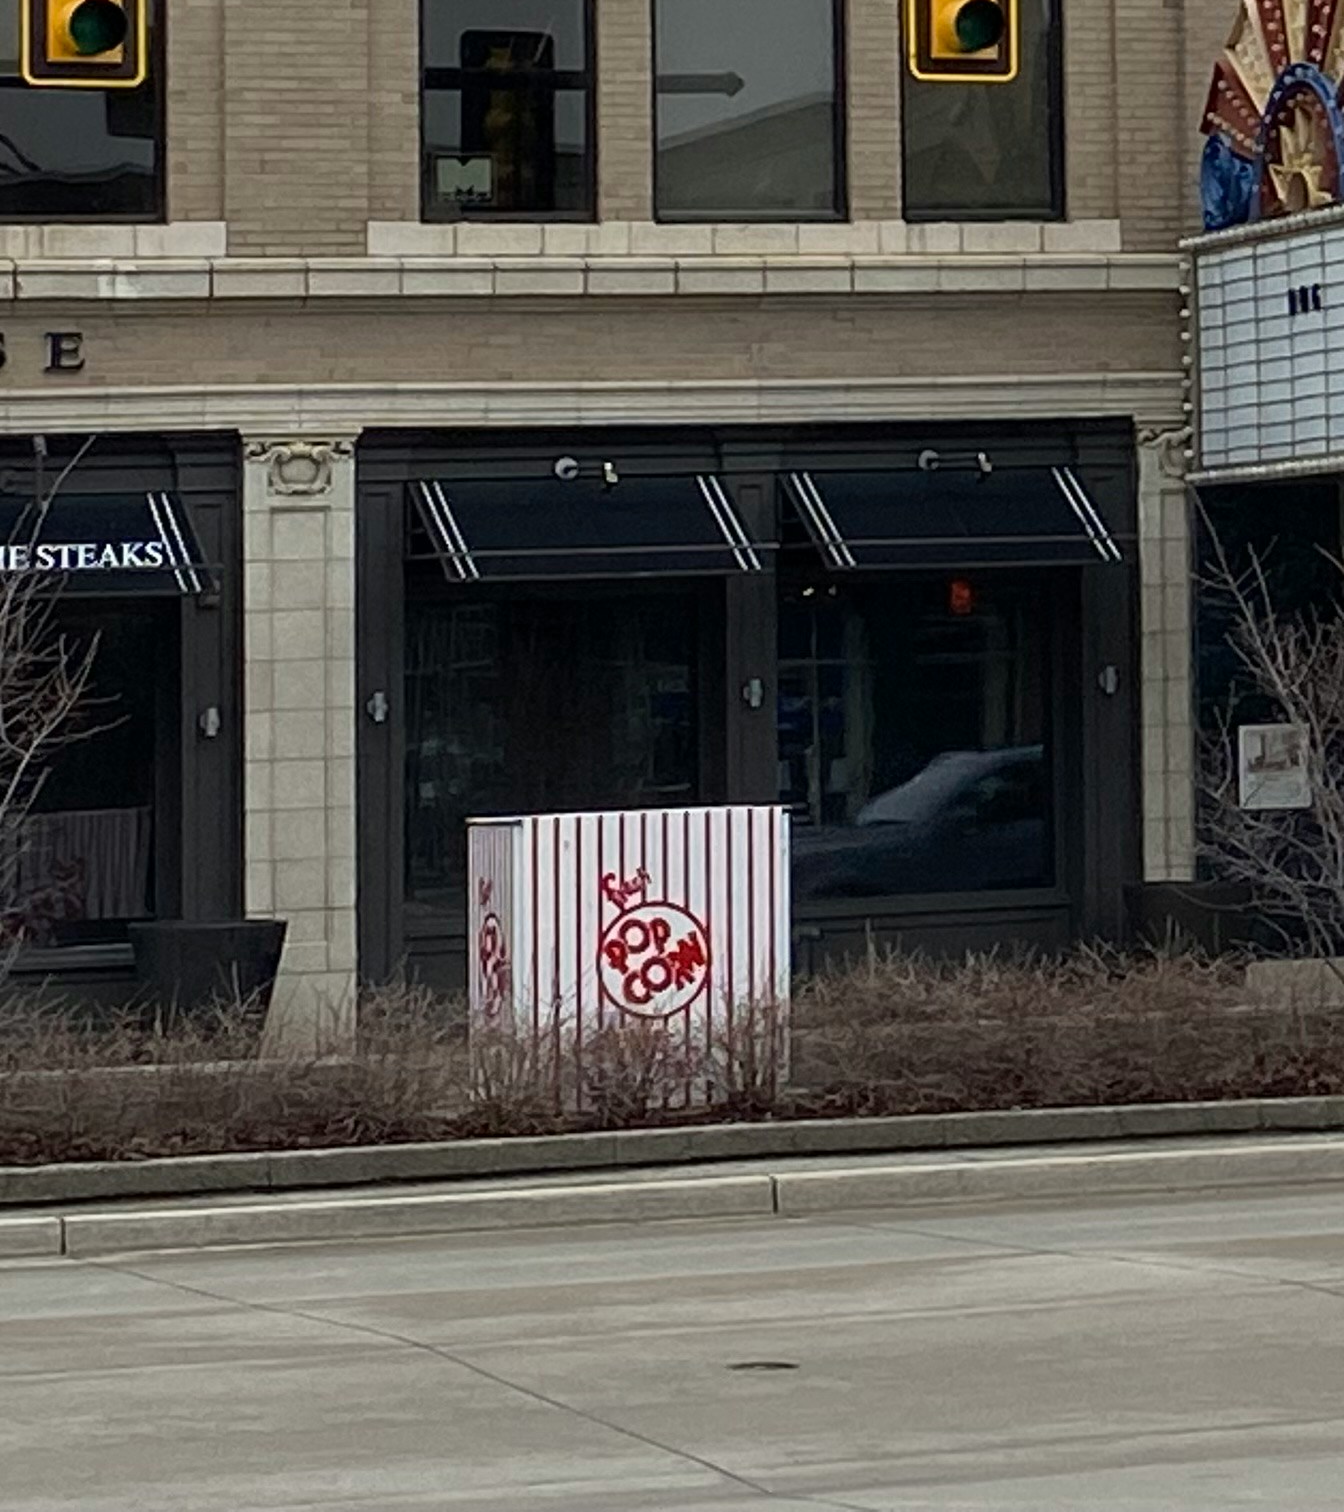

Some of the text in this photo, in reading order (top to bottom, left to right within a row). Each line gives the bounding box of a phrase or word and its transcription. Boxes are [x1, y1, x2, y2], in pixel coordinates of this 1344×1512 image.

[0, 332, 86, 373] E
[0, 541, 164, 571] E STEAKS
[604, 918, 671, 974] POP
